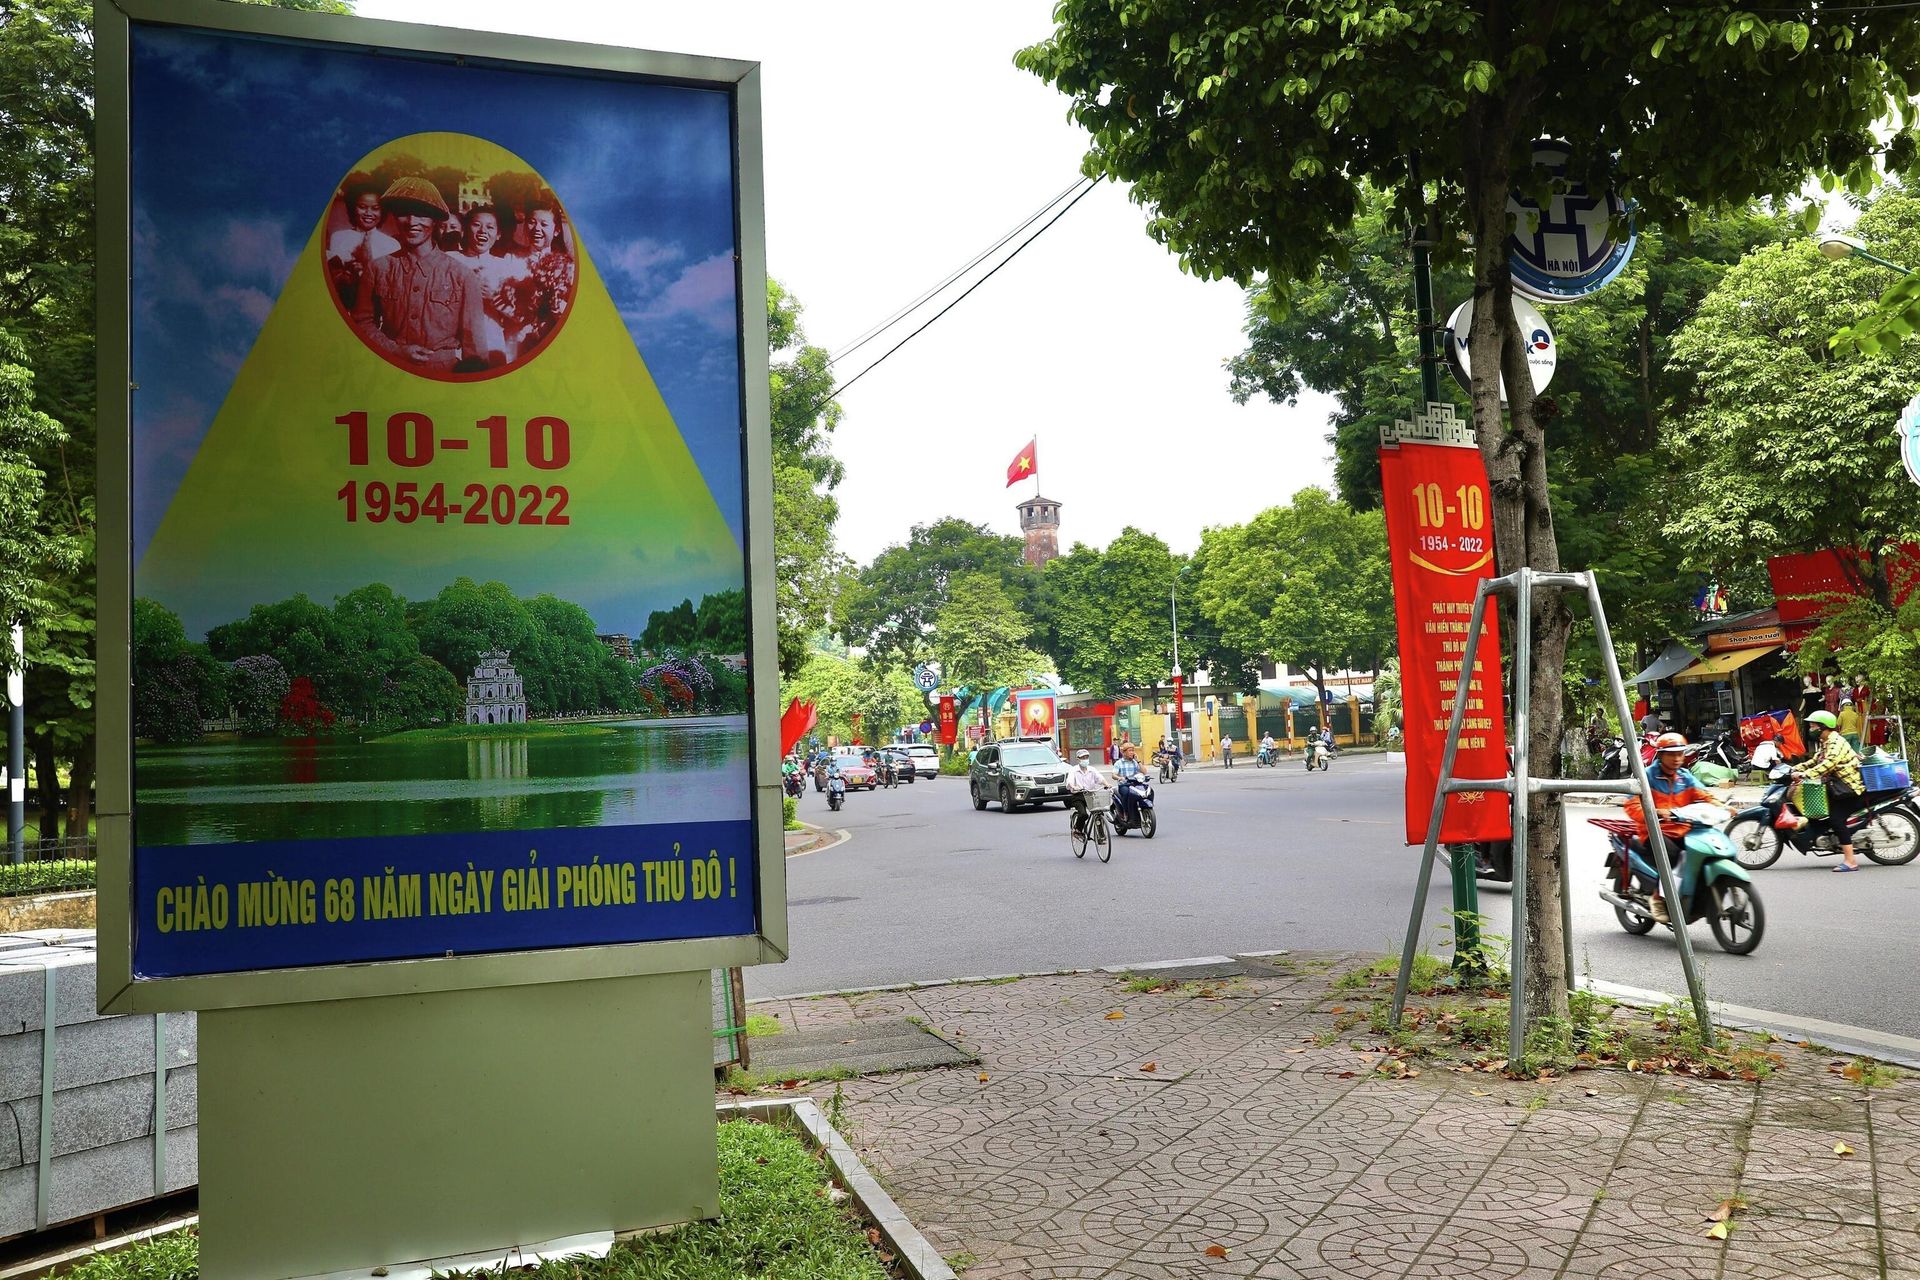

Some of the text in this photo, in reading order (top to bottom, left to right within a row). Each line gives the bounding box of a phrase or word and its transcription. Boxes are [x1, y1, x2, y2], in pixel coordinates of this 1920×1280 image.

[1548, 258, 1578, 274] HÀ NỘI
[335, 411, 571, 470] 10-10
[337, 480, 570, 525] 1954-2022
[1420, 535, 1449, 551] 1954
[1459, 536, 1483, 553] 2022
[157, 875, 228, 933] CHÀO
[237, 870, 316, 927] MỪNG
[324, 878, 355, 922] 68
[363, 866, 421, 920] NĂM
[429, 862, 494, 916] NGÀY
[503, 849, 549, 912] GIẢI
[557, 855, 636, 908] PHÓNG
[642, 842, 685, 902] THỦ
[692, 850, 722, 900] ĐÔ
